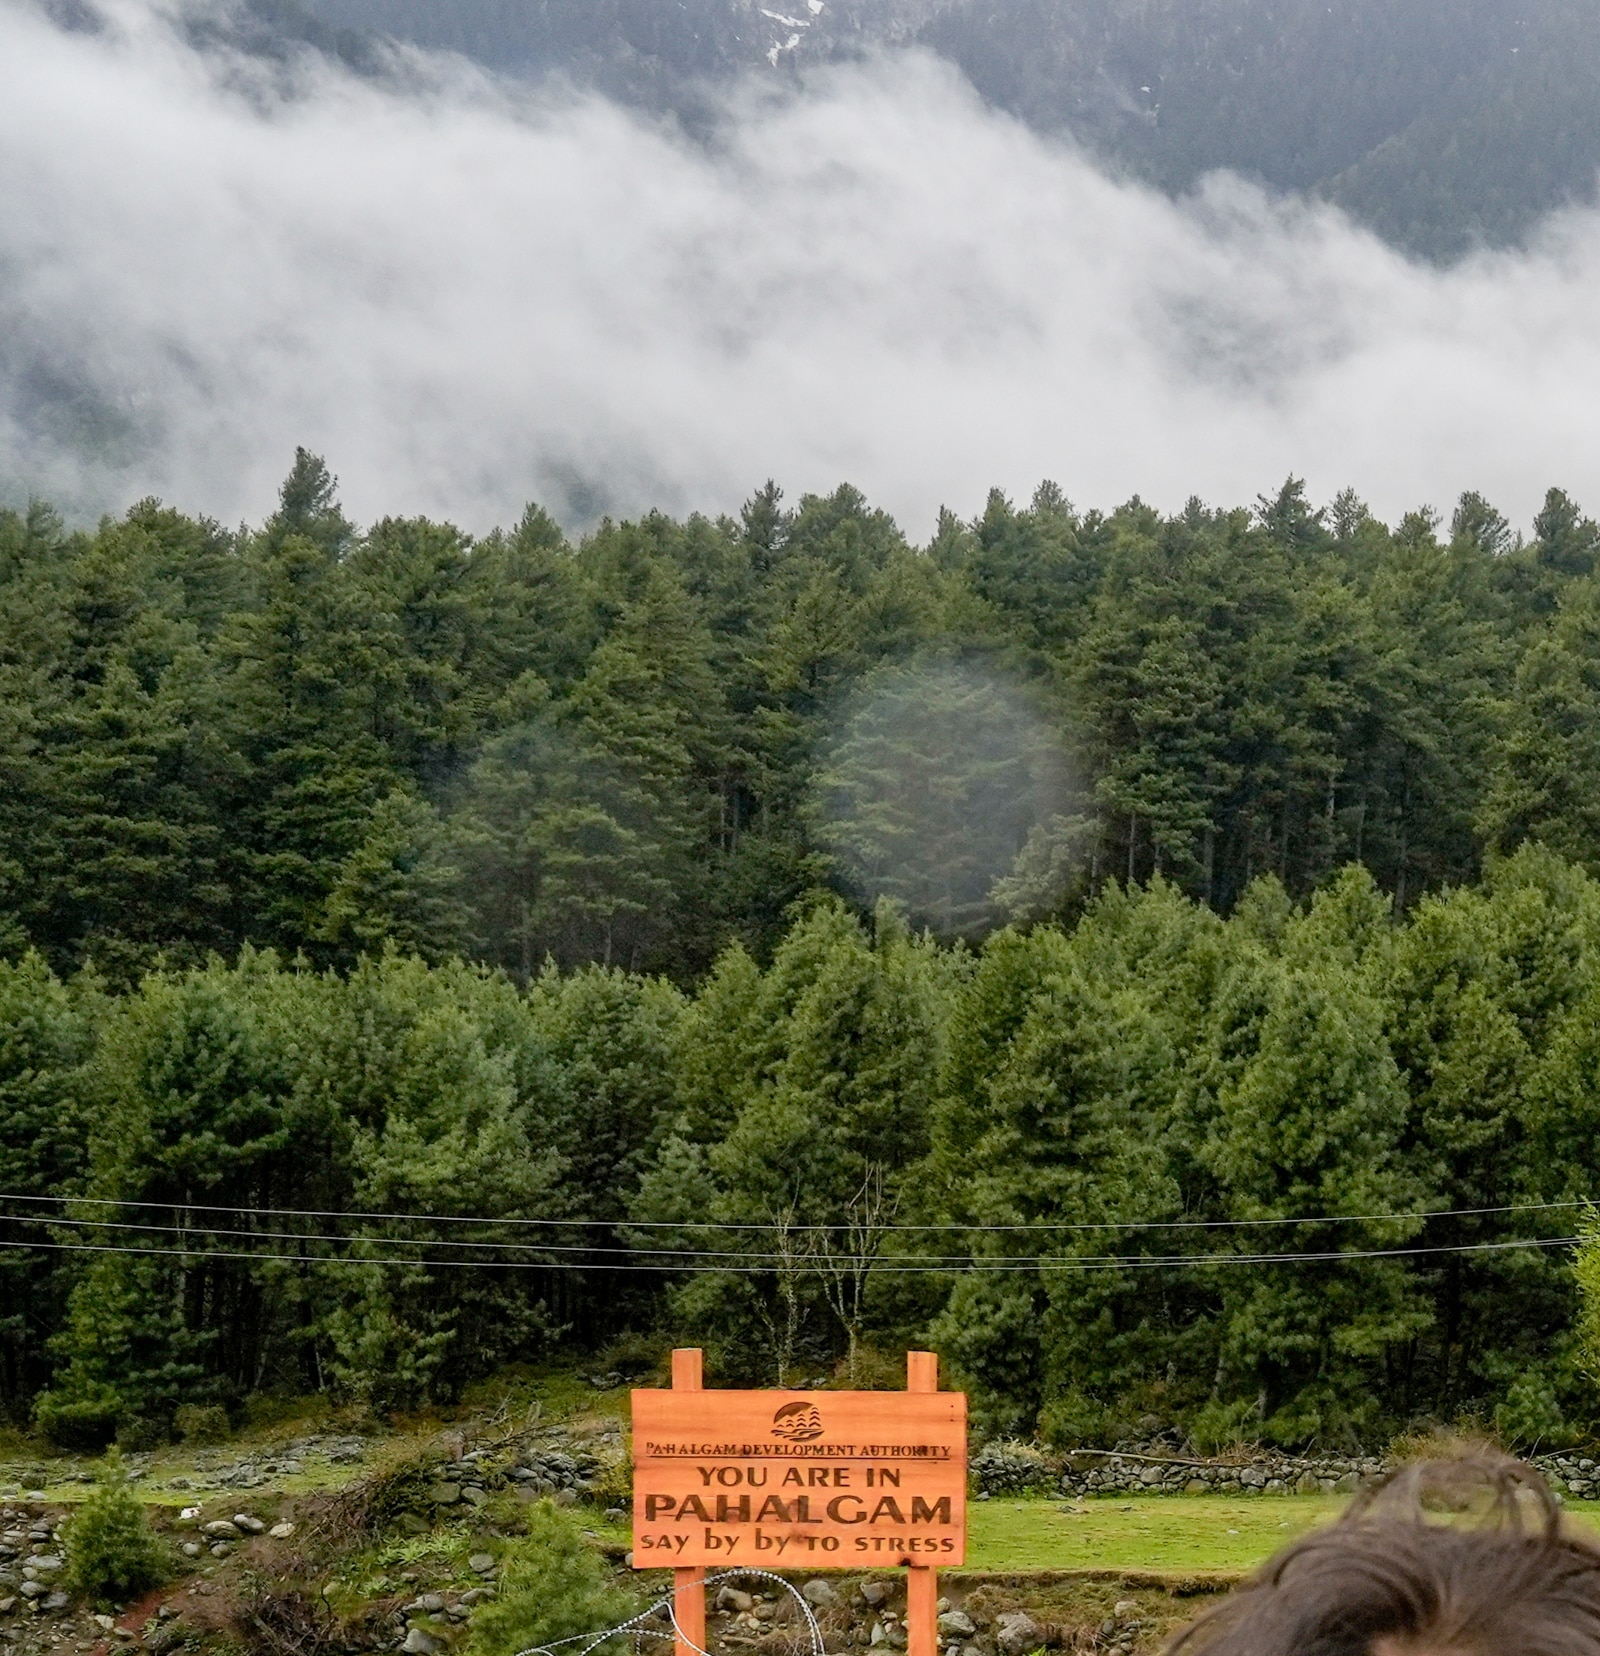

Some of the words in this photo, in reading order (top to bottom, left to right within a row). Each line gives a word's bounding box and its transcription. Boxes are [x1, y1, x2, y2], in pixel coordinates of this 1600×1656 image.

[646, 1442, 737, 1456] PAHALGAM
[743, 1444, 855, 1456] DEVELOPMENT
[860, 1445, 951, 1457] AUTHORITY
[696, 1467, 768, 1487] YOU
[782, 1468, 850, 1487] ARE
[867, 1468, 900, 1487] IN
[645, 1494, 951, 1524] PAHALGAM
[805, 1536, 839, 1551] TO
[855, 1537, 954, 1552] STRESS
